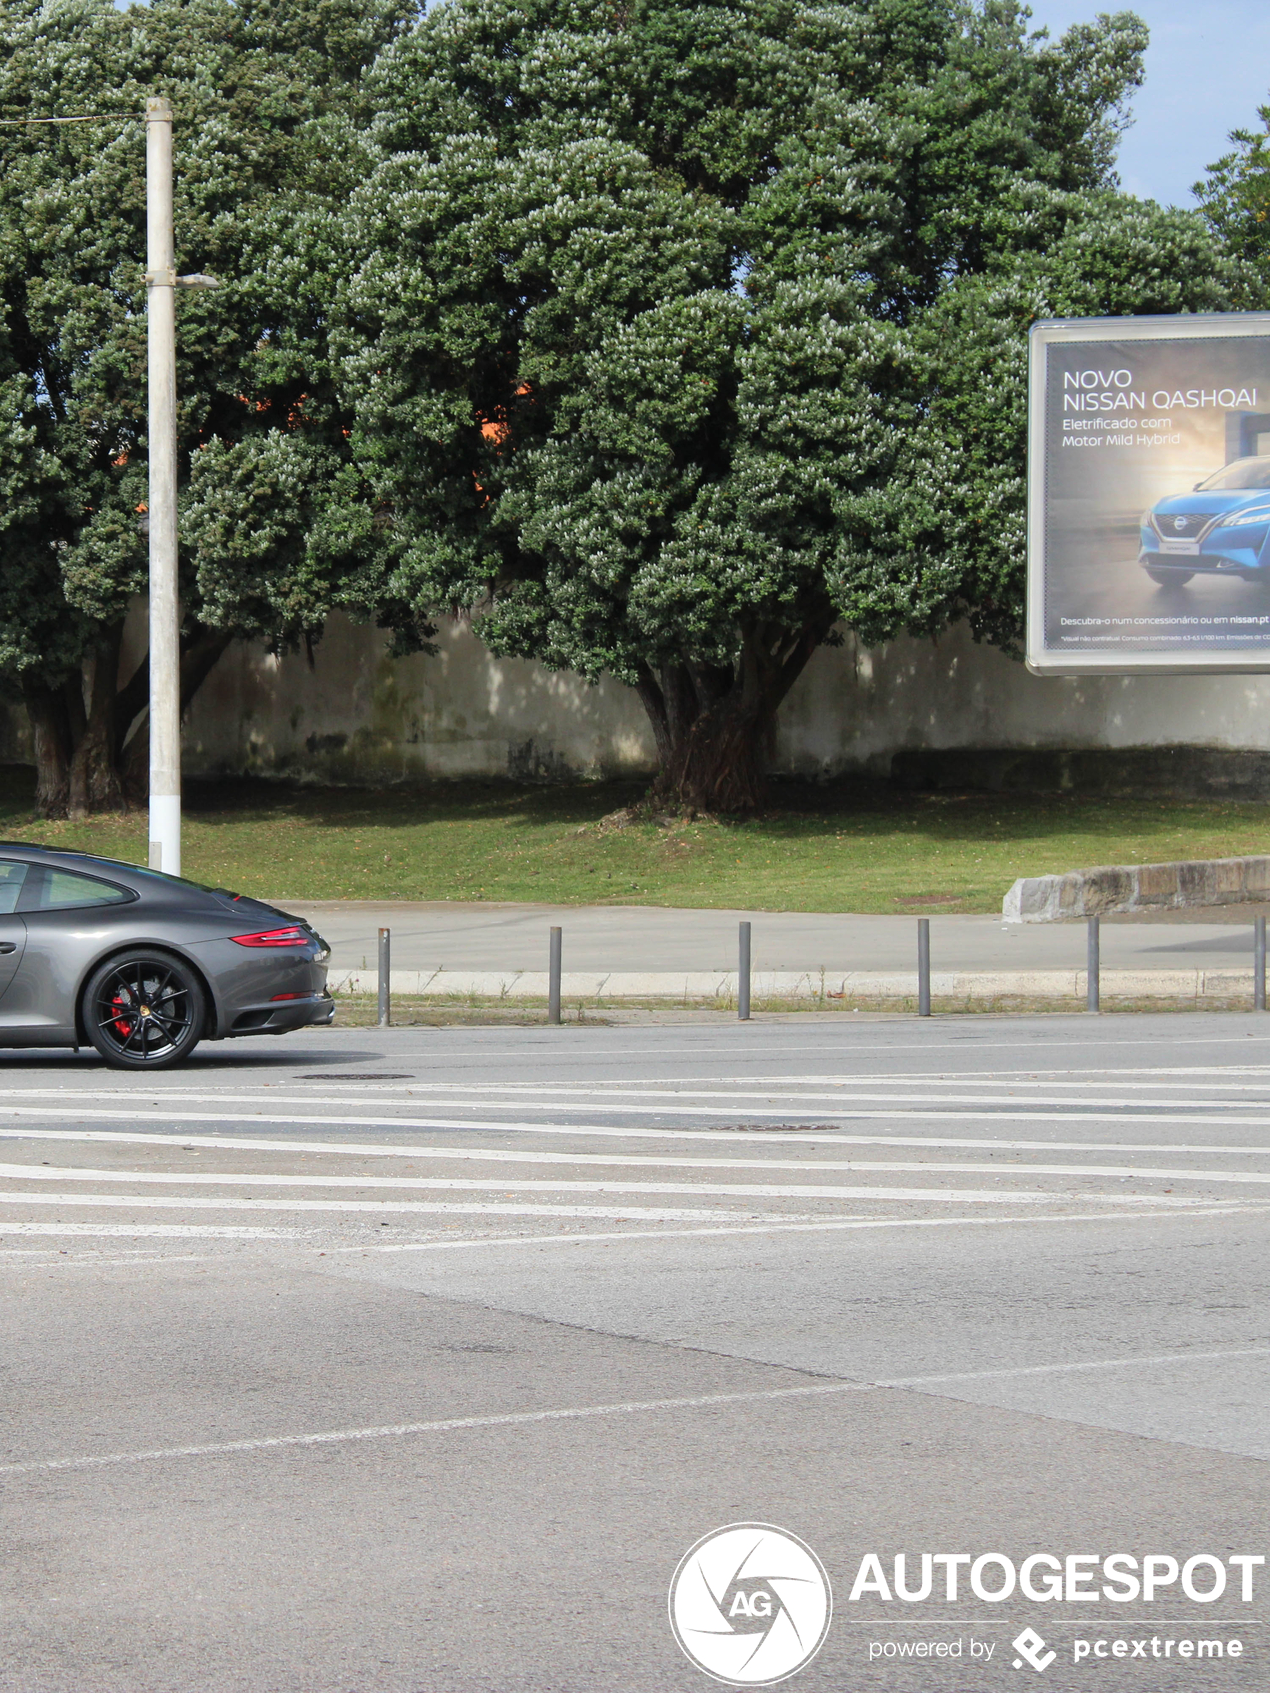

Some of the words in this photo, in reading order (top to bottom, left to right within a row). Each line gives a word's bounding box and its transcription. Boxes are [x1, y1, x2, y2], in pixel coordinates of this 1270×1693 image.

[1063, 369, 1132, 388] NOVO
[1063, 391, 1145, 411] NISSAN
[1152, 388, 1257, 410] QASHQAI
[1062, 417, 1138, 430] Eletrificado
[1140, 417, 1172, 429] com
[1062, 434, 1102, 447] Motor
[1106, 433, 1133, 446] Mild
[1136, 432, 1180, 447] Hybrid
[1060, 617, 1111, 626] Descubra-o
[1112, 617, 1132, 625] num
[1134, 616, 1198, 625] concessionário
[1230, 615, 1269, 626] nissan.pt
